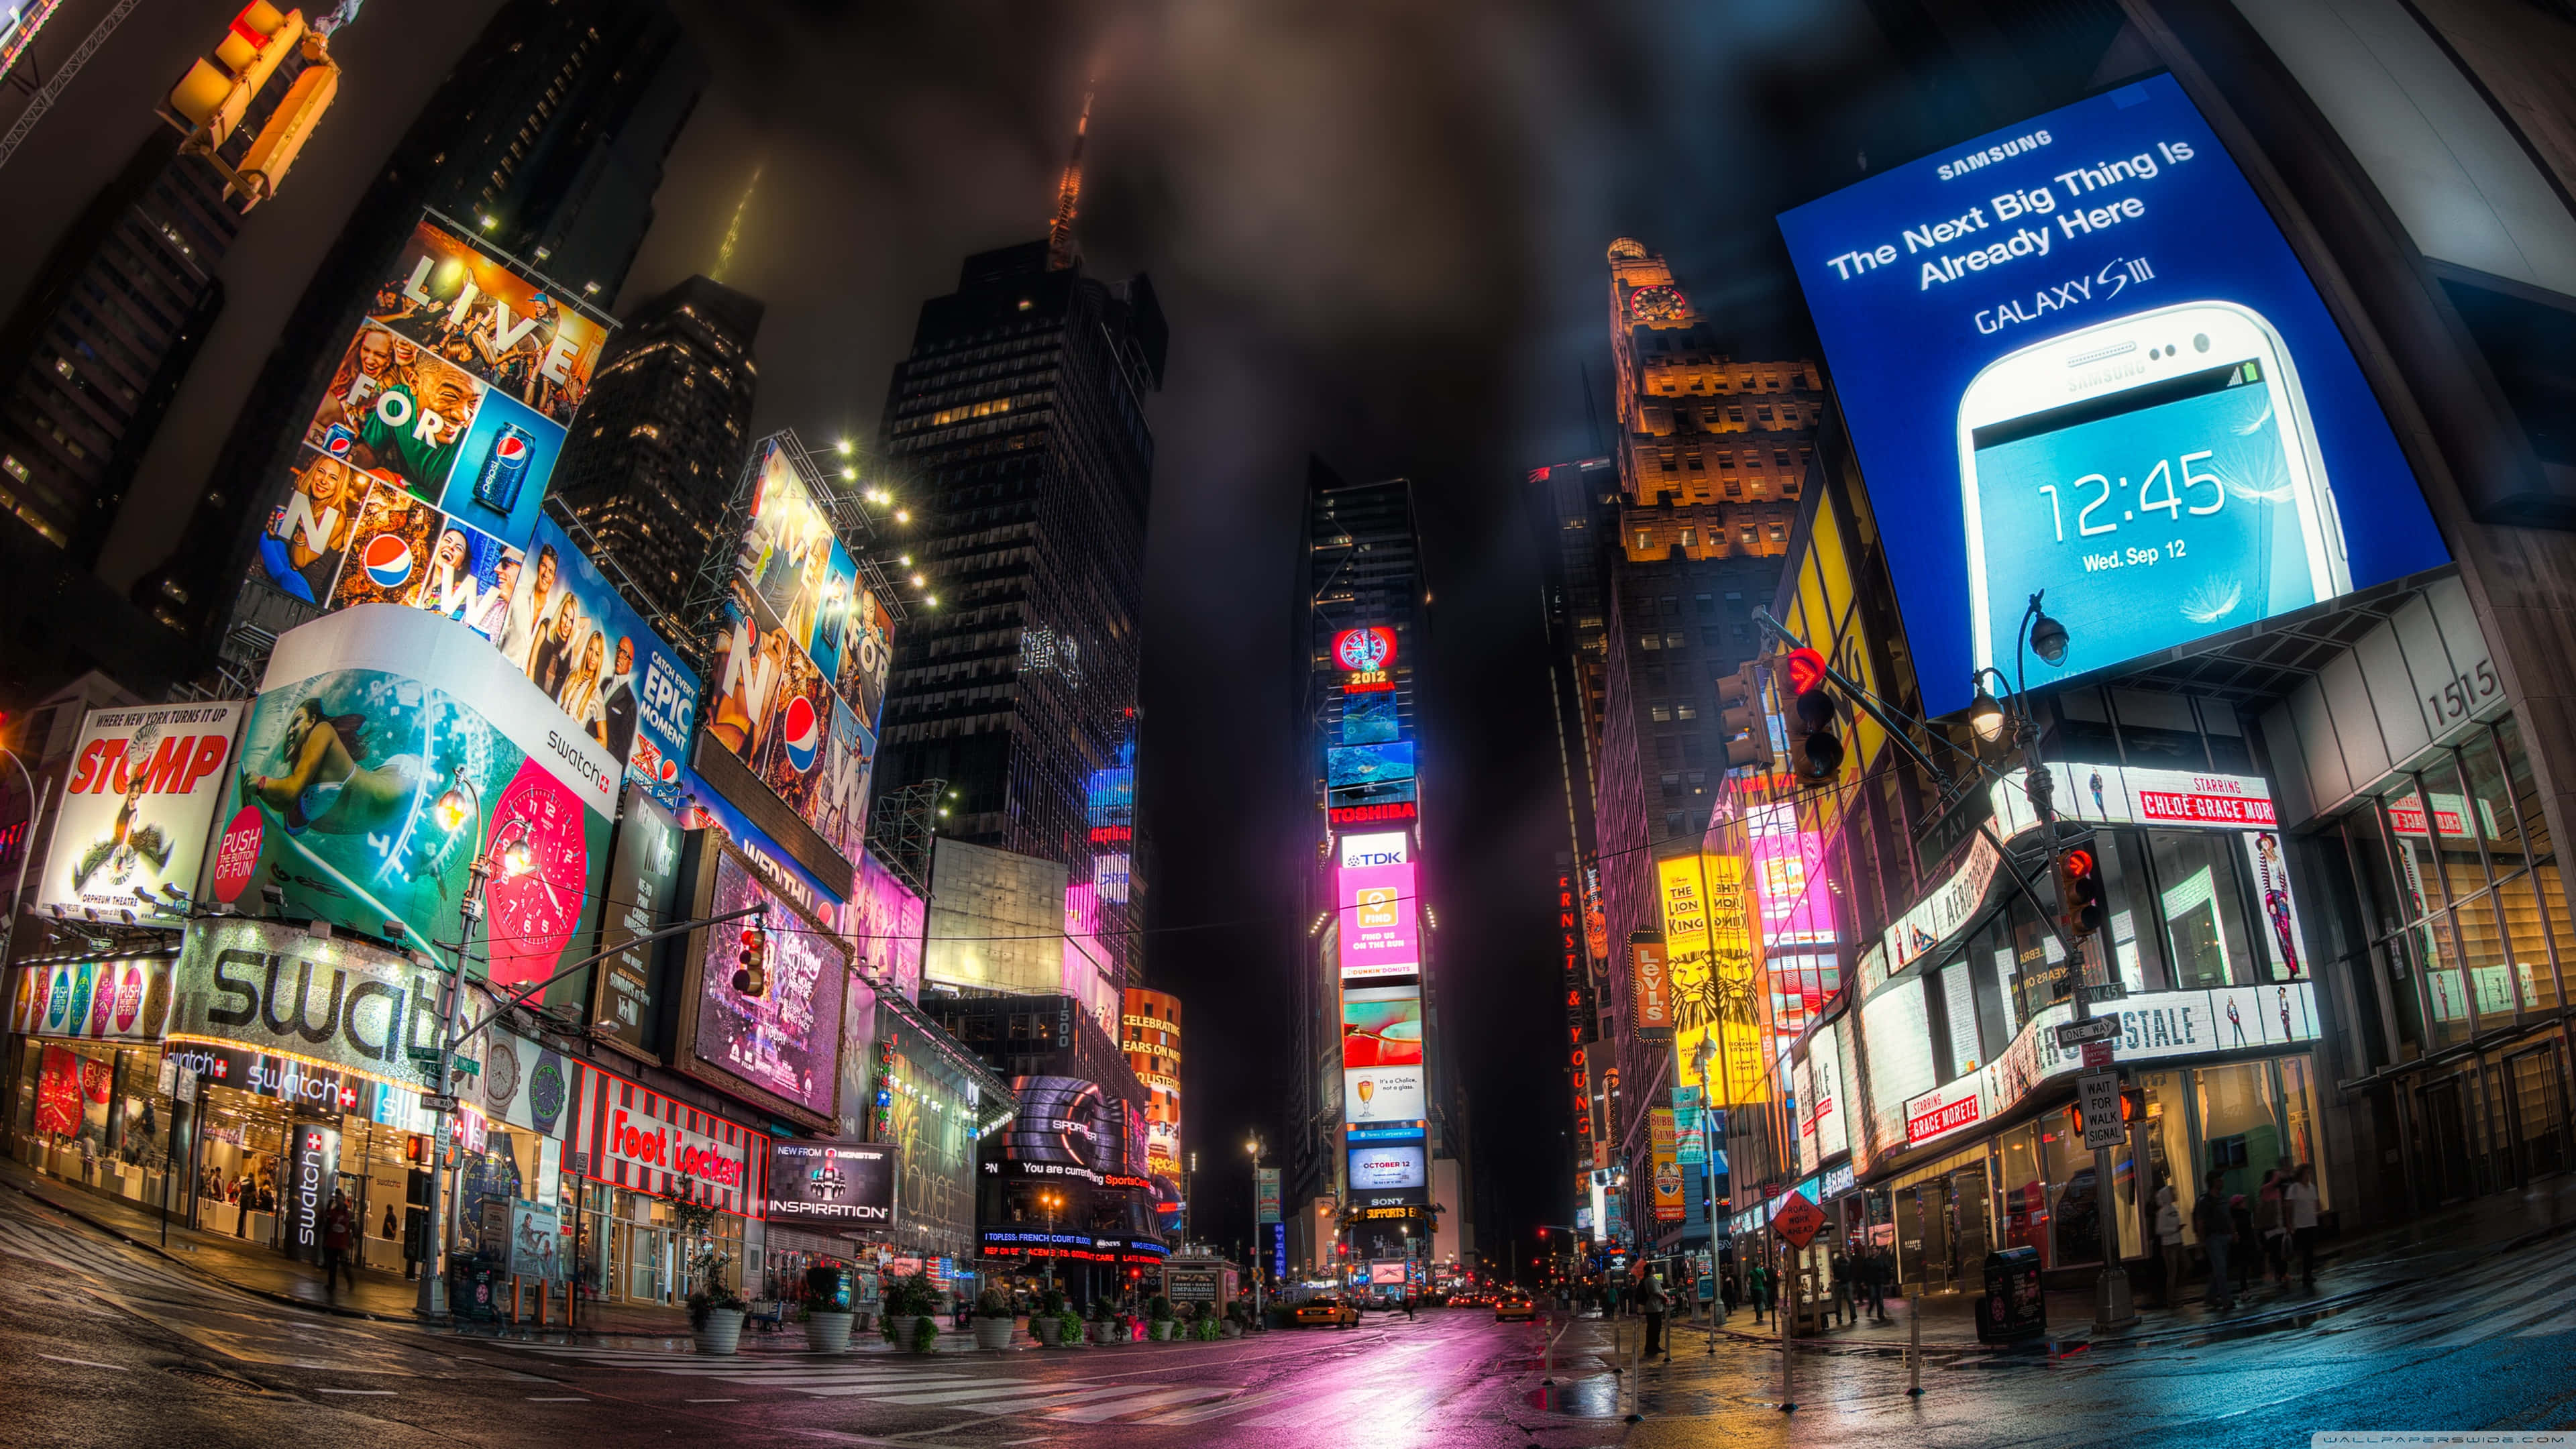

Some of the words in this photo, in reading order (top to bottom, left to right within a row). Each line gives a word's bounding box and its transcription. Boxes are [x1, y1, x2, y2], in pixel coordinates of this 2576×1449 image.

[1937, 130, 2053, 181] SAMSUNG
[1827, 239, 1897, 282] The
[1902, 205, 1989, 255] Next
[1991, 184, 2056, 224] Big
[2054, 149, 2159, 200] Thing
[2157, 139, 2195, 168] Is
[1920, 227, 2051, 290] Already
[2060, 197, 2145, 239] Here
[1974, 276, 2092, 335] GALAXY
[402, 255, 580, 385] LIVE
[2068, 359, 2145, 393] SAMSUNG
[347, 374, 444, 449] FOR
[482, 460, 500, 494] pepsi
[2039, 449, 2226, 542] 12:45
[2082, 551, 2124, 574] Wed.
[2127, 545, 2159, 572] Sep
[2165, 540, 2186, 559] 12
[848, 616, 890, 698] FOR
[651, 650, 675, 681] CATCH
[674, 673, 696, 698] EVERY
[1352, 672, 1386, 684] 2012
[1343, 681, 1395, 693] TOSHIBA
[2428, 659, 2496, 727] 1515
[644, 663, 694, 736] EPIC
[95, 713, 123, 729] WHERE
[123, 712, 145, 726] NEW
[146, 710, 170, 724] YORK
[170, 709, 200, 723] TURNS
[201, 708, 211, 722] IT
[211, 708, 228, 722] UP
[639, 700, 687, 751] MOMENT
[68, 735, 229, 795] STOMP
[547, 729, 602, 787] swatch
[2194, 777, 2241, 794] STARRING
[1329, 803, 1415, 823] TOSHIBA
[2145, 794, 2190, 816] CHLOË
[2196, 798, 2240, 819] GRACE
[222, 829, 260, 853] PUSH
[1936, 829, 1945, 851] 7
[220, 853, 231, 862] THE
[231, 851, 256, 863] BUTTON
[1360, 851, 1401, 865] TDK
[216, 865, 231, 880] OF
[232, 861, 253, 877] FUN
[83, 894, 110, 905] ORPHEUM
[112, 896, 139, 907] THEATRE
[1669, 885, 1693, 898] THE
[1668, 900, 1699, 916] LION
[1365, 913, 1392, 923] FIND
[1560, 877, 1576, 970] ERNST
[1668, 917, 1705, 936] KING
[1353, 942, 1366, 950] ON
[1387, 940, 1404, 948] RUN
[1361, 932, 1382, 941] FIND
[1384, 932, 1395, 940] US
[54, 985, 68, 1000] PUSH
[120, 984, 141, 999] PUSH
[610, 972, 635, 997] SUNDAYS
[2090, 987, 2101, 1001] W
[2104, 985, 2118, 1000] 45
[1568, 990, 1580, 1006] &
[1059, 998, 1070, 1048] 1500
[1122, 1014, 1181, 1037] CELEBRATING
[2065, 1029, 2085, 1040] ONE
[2092, 1021, 2111, 1036] WAY
[763, 1022, 788, 1046] TODAY
[1153, 1044, 1167, 1058] ON
[2086, 1049, 2109, 1059] ANYTIME
[248, 1065, 339, 1104] swatch
[1146, 1073, 1175, 1089] LISTED
[1395, 1077, 1417, 1085] Chalice,
[1398, 1083, 1415, 1092] glass.
[1570, 1026, 1589, 1134] YOUNG
[2086, 1081, 2112, 1096] WAIT
[425, 1097, 435, 1106] ONE
[439, 1099, 453, 1108] WAY
[1913, 1093, 1942, 1116] STARRING
[2091, 1096, 2112, 1110] FOR
[1913, 1114, 1941, 1138] GRACE
[1941, 1097, 1977, 1128] MORETZ
[2088, 1111, 2118, 1128] WALK
[2089, 1126, 2121, 1143] SIGNAL
[611, 1108, 667, 1168] Foot
[673, 1130, 744, 1188] Locker
[777, 1146, 798, 1156] NEW
[798, 1148, 822, 1158] FROM
[837, 1150, 882, 1161] MONSTER
[1023, 1162, 1045, 1174] You
[1046, 1165, 1064, 1175] are
[1362, 1161, 1401, 1170] OCTOBER
[299, 1149, 323, 1246] swatch
[1371, 1197, 1405, 1206] SONY
[769, 1199, 885, 1220] INSPIRATION
[1366, 1208, 1406, 1220] SUPPORTS
[1787, 1205, 1810, 1214] ROAD
[1788, 1215, 1810, 1225] WORK
[989, 1232, 1018, 1242] TOPLESS:
[1019, 1234, 1050, 1242] FRENCH
[1051, 1234, 1075, 1244] COURT
[1786, 1225, 1815, 1236] AHEAD
[984, 1247, 999, 1256] REF
[1095, 1253, 1116, 1263] CARE
